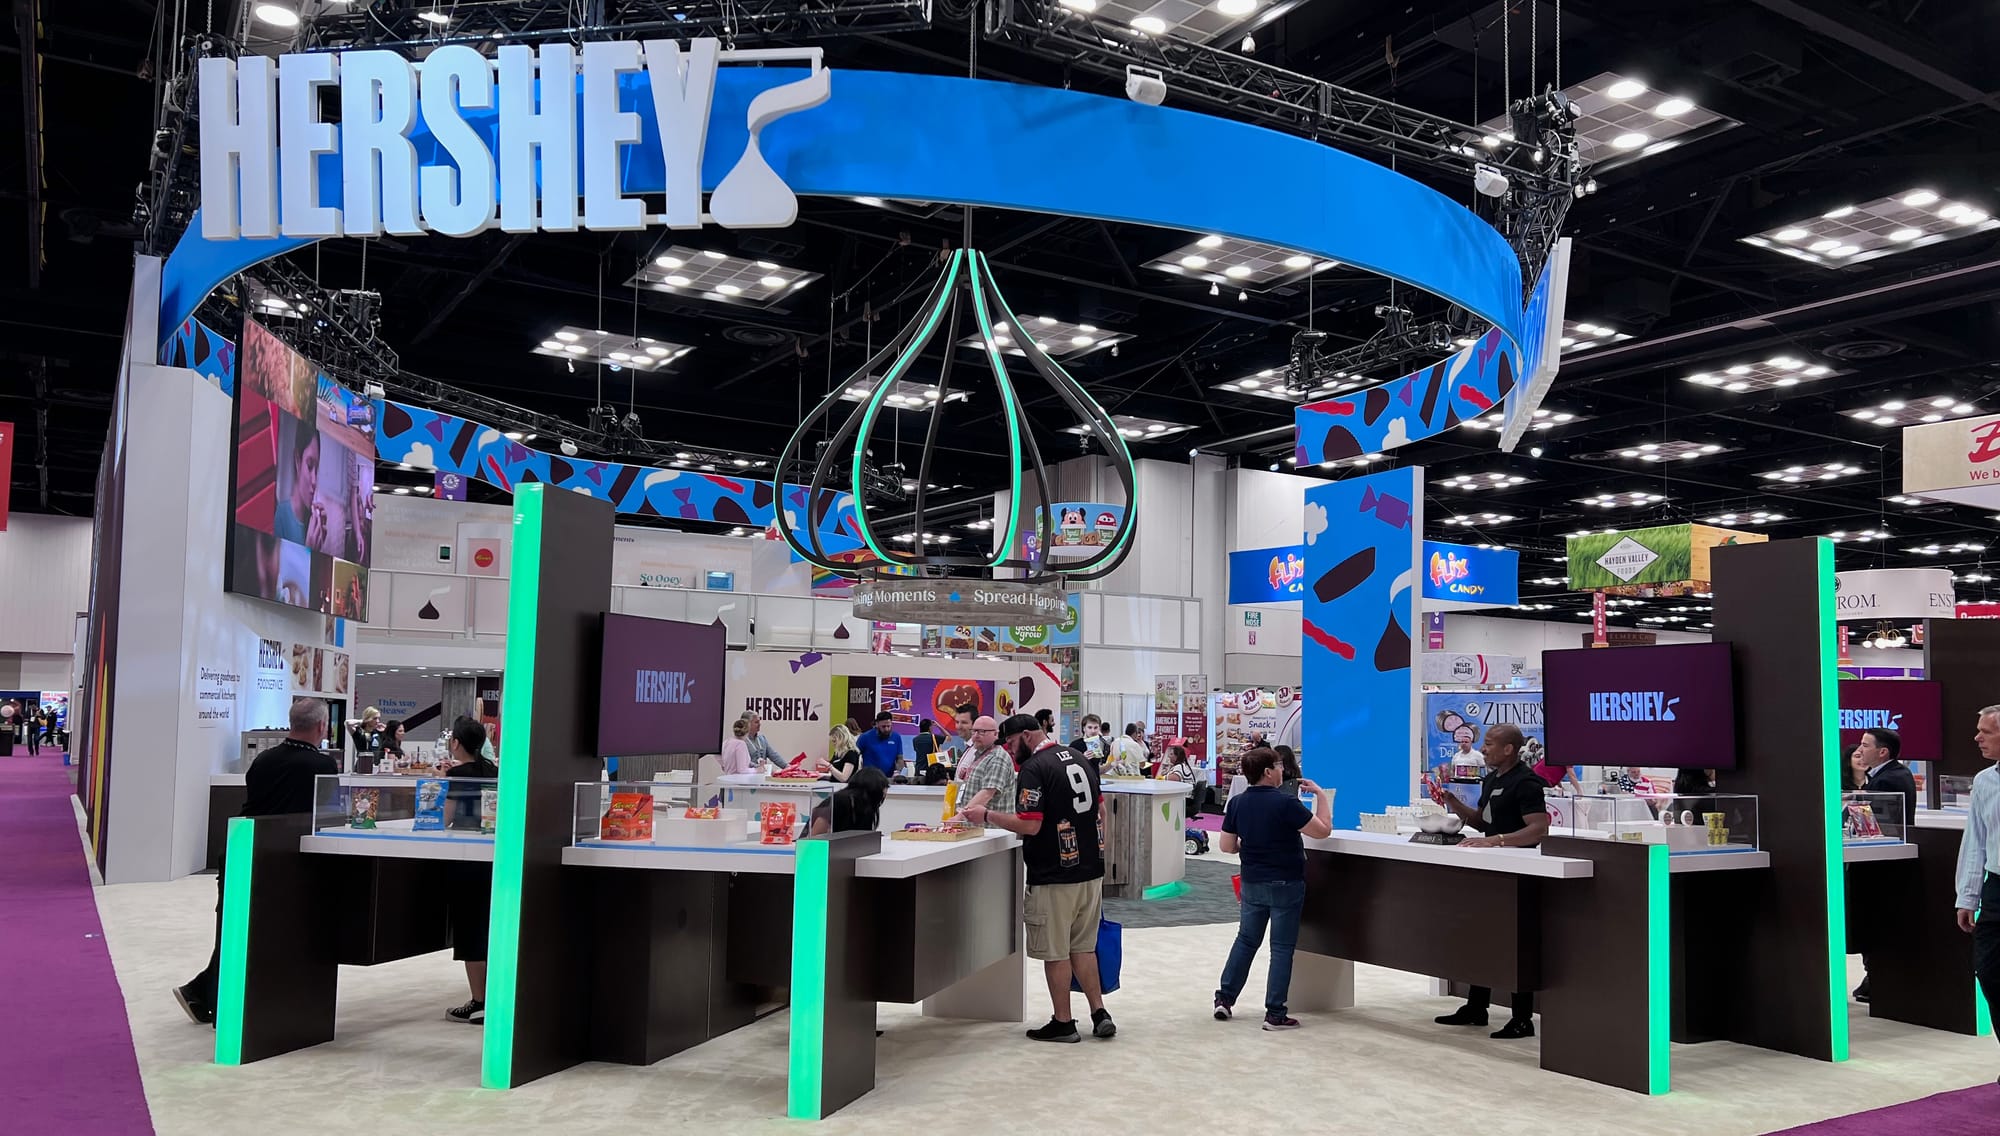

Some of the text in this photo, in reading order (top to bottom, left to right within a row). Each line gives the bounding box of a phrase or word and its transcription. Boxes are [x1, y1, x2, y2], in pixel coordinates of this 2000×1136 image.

[199, 37, 721, 240] HERSHEY
[1970, 471, 1989, 480] We
[1604, 554, 1649, 566] HAYDEN VALLEY
[875, 590, 936, 603] Moments
[974, 589, 1026, 604] Spread
[1449, 584, 1484, 594] CANDY
[1837, 594, 1877, 609] ROM
[635, 669, 687, 704] HERSHEY
[849, 687, 870, 704] HERSHEY
[378, 698, 417, 709] This way
[745, 697, 811, 721] HERSHEY
[1589, 691, 1665, 721] HERSHEY
[1248, 720, 1271, 729] Snack
[1839, 709, 1890, 730] ERSHEY
[1056, 750, 1073, 761] LEE
[1066, 763, 1093, 814] 9
